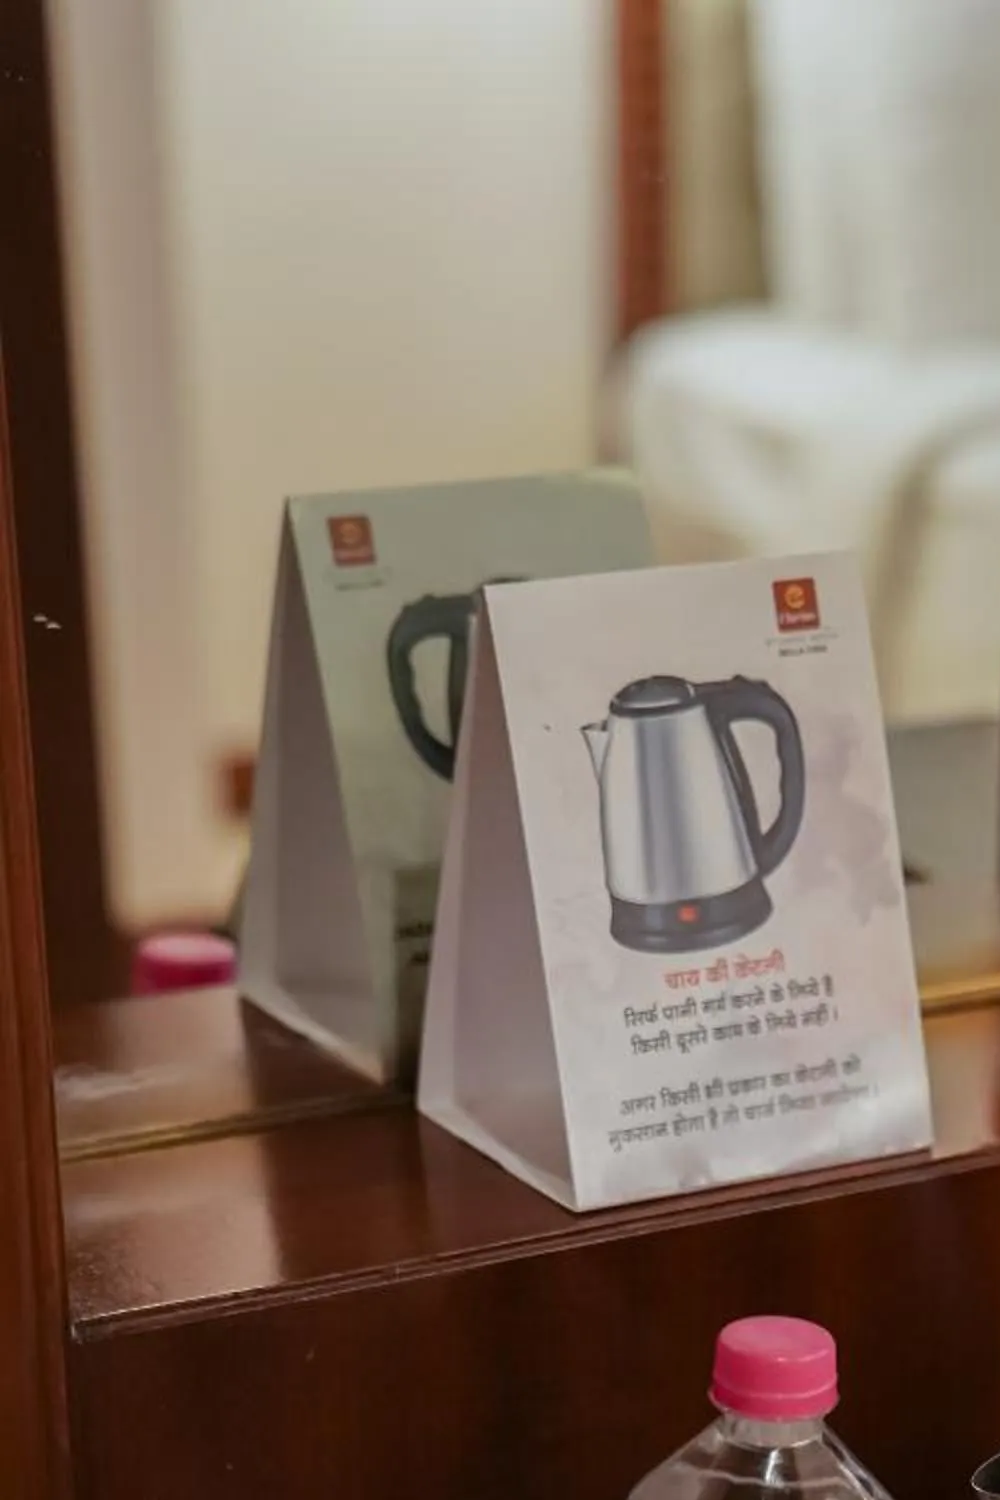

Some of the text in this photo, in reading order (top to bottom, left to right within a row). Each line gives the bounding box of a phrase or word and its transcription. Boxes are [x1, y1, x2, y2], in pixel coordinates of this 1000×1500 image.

[706, 957, 729, 983] की
[661, 996, 697, 1021] पानी
[630, 1029, 672, 1055] किसी
[675, 1023, 709, 1054] दूसरे
